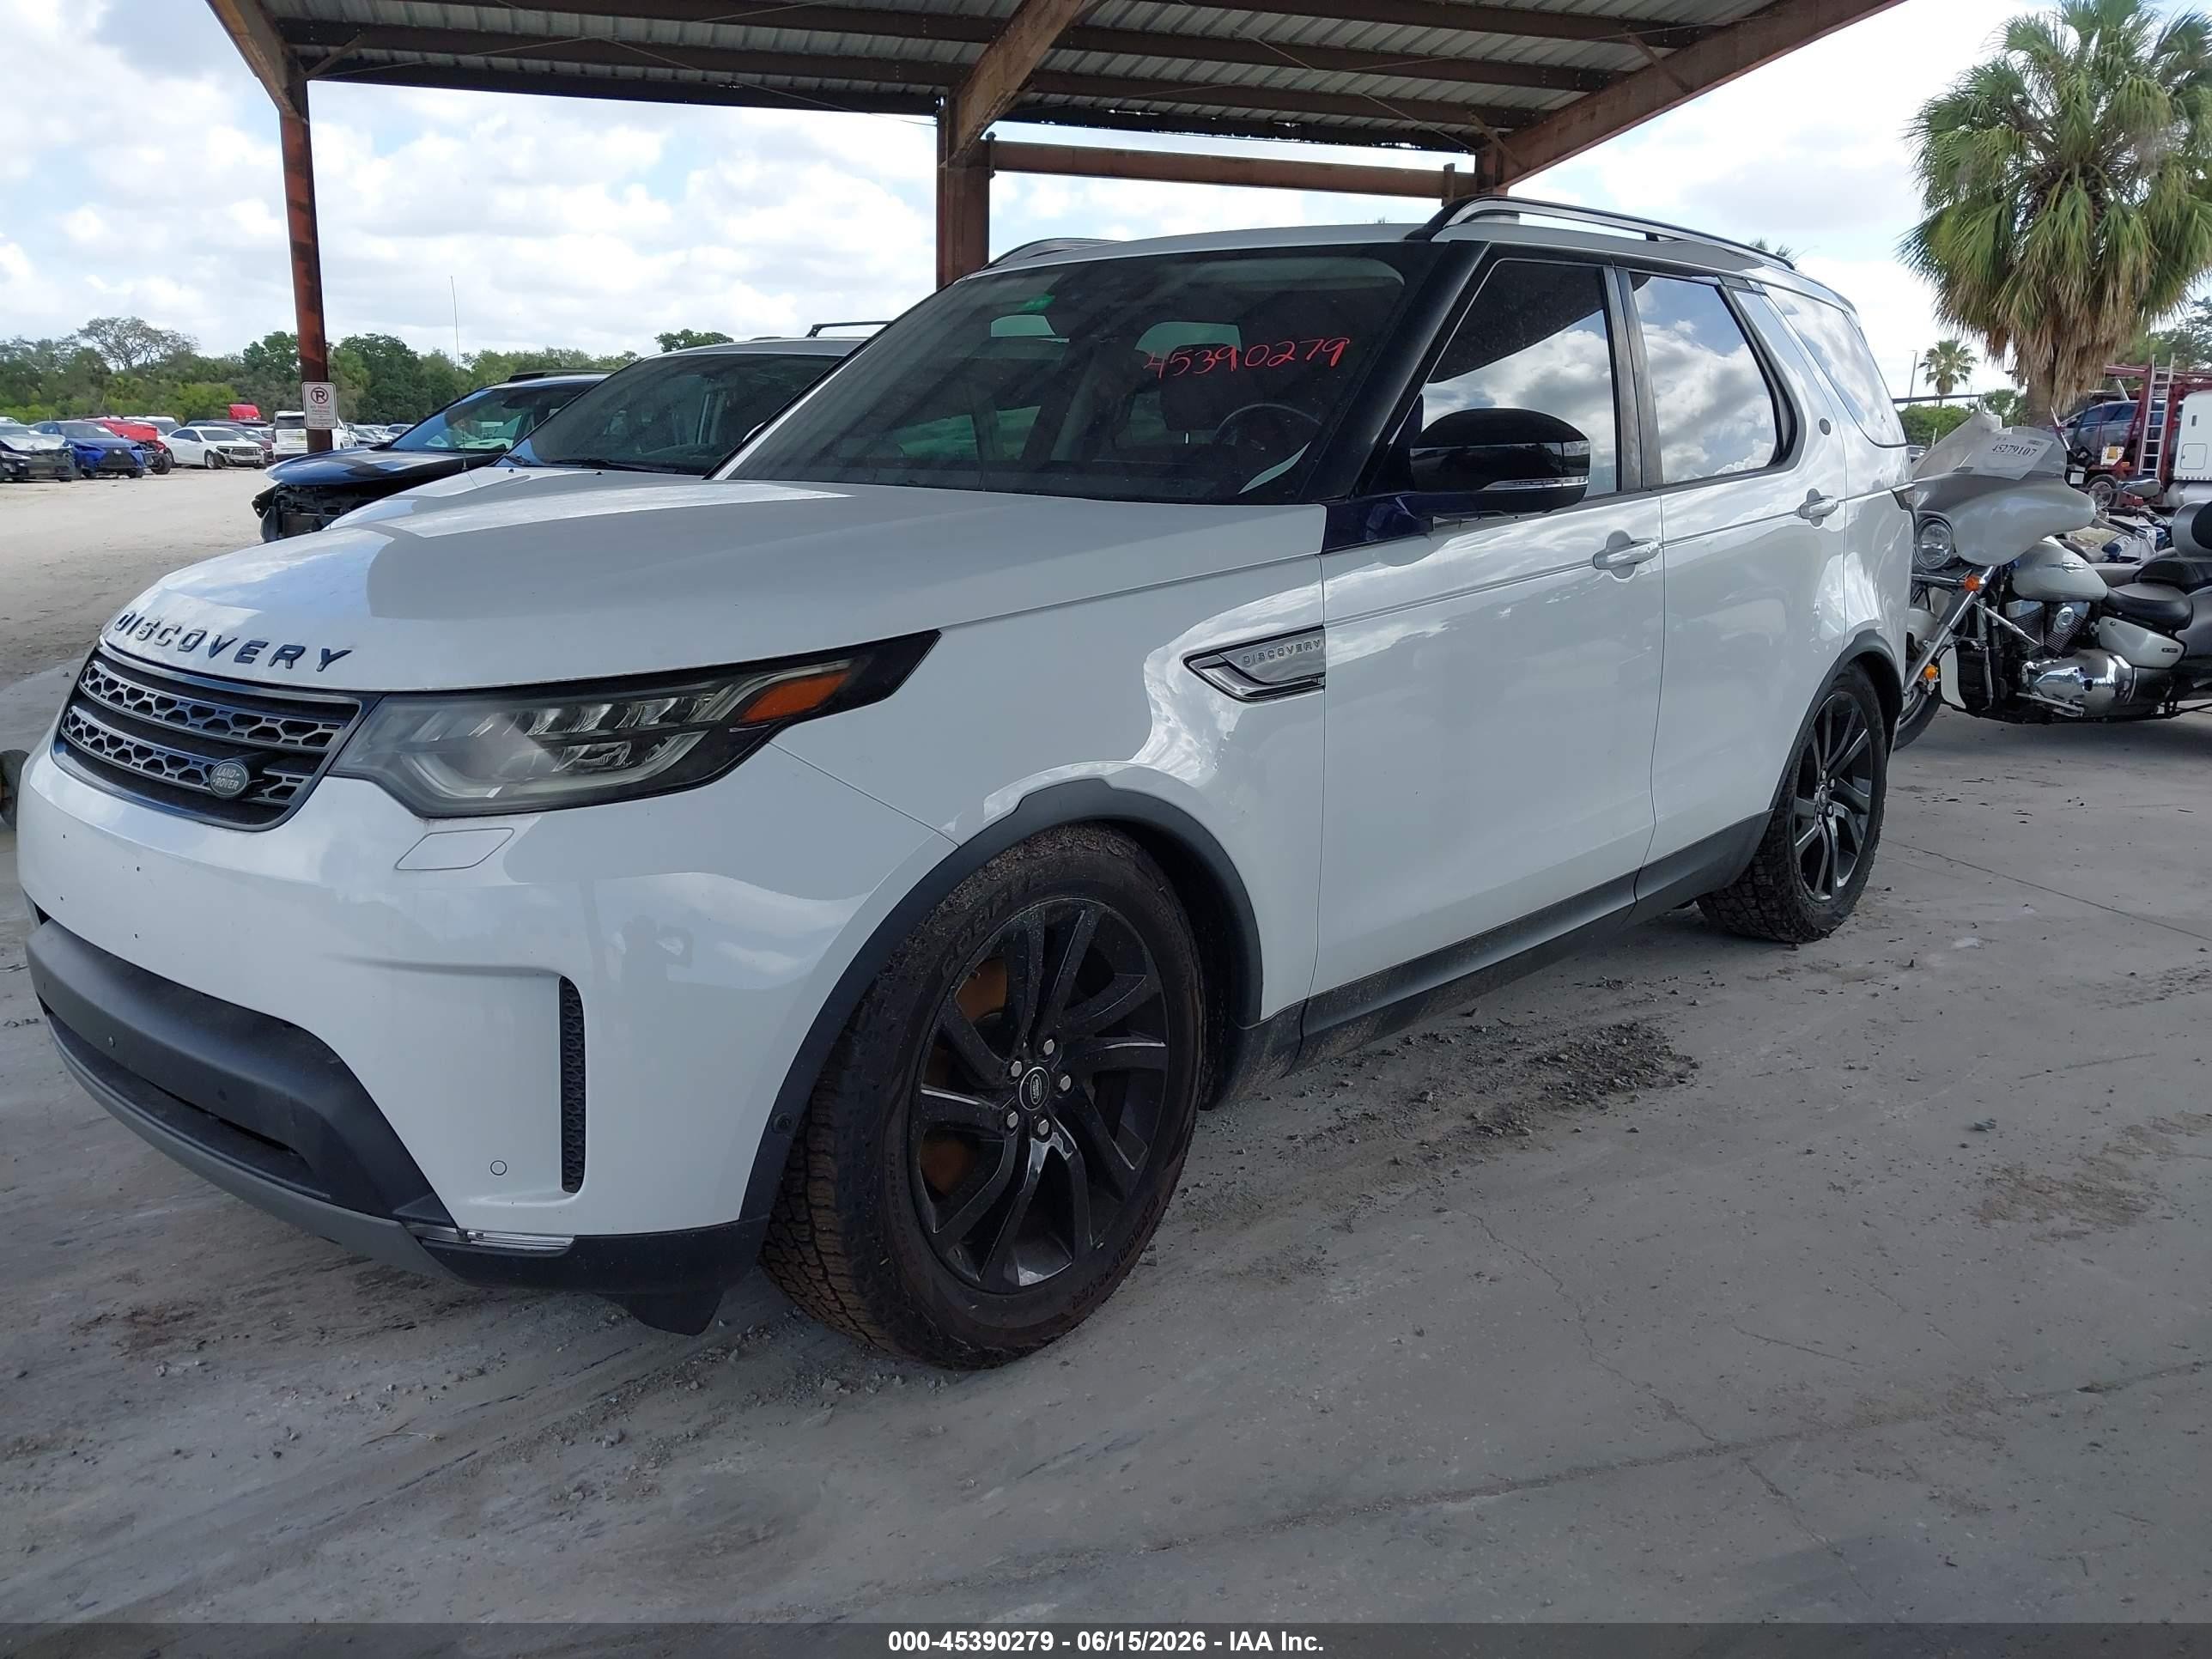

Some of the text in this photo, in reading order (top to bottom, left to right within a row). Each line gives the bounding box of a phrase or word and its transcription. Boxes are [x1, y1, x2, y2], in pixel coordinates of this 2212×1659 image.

[1143, 337, 1351, 379] 45390279
[1992, 444, 2038, 458] 45279107
[113, 610, 353, 672] DISCOVERY
[1243, 639, 1321, 665] DISCOVERY
[216, 767, 237, 779] LAND
